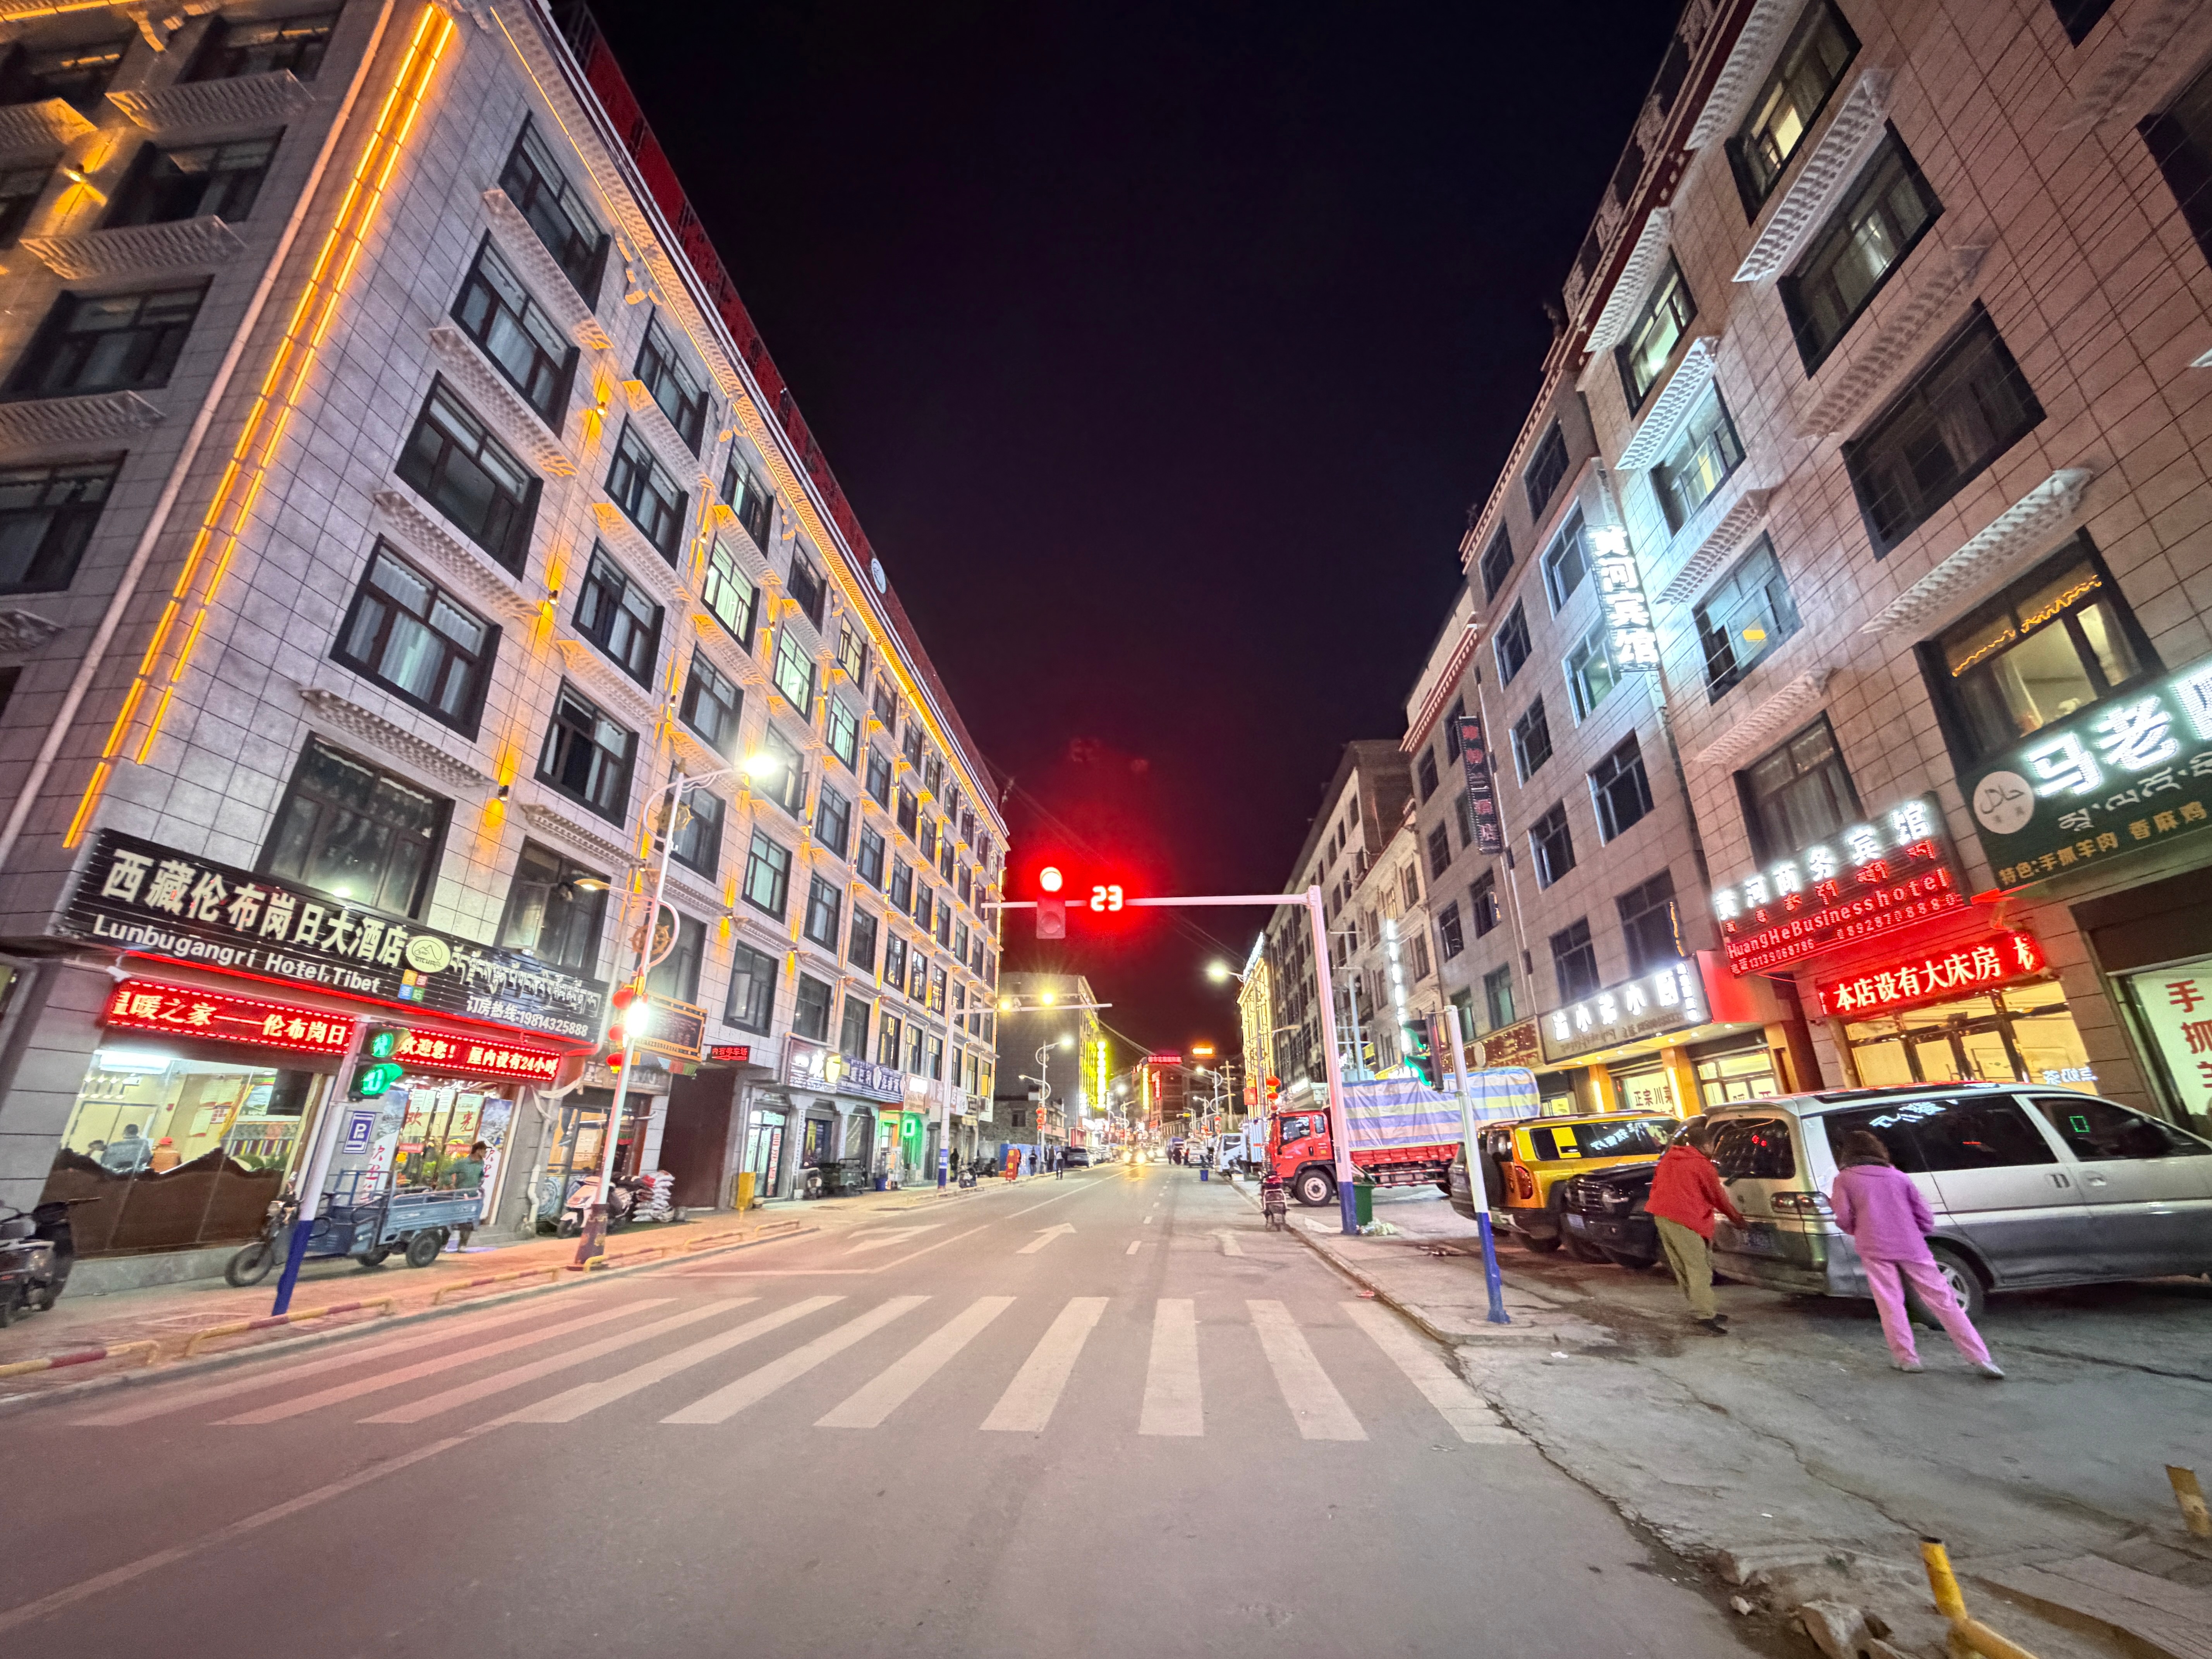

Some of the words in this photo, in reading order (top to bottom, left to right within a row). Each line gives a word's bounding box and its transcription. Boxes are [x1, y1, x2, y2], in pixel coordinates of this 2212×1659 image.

[1589, 525, 1659, 663] 黄河宾馆
[1716, 802, 1932, 920] 黄河商务宾馆
[101, 848, 408, 967] 西藏伦布岗日大酒店
[1090, 884, 1123, 912] 23
[93, 914, 256, 968] Lunbugangri
[1833, 946, 2001, 1011] 本店设有大床房
[1633, 1085, 1672, 1106] 正宗川菜
[354, 1123, 366, 1139] P
